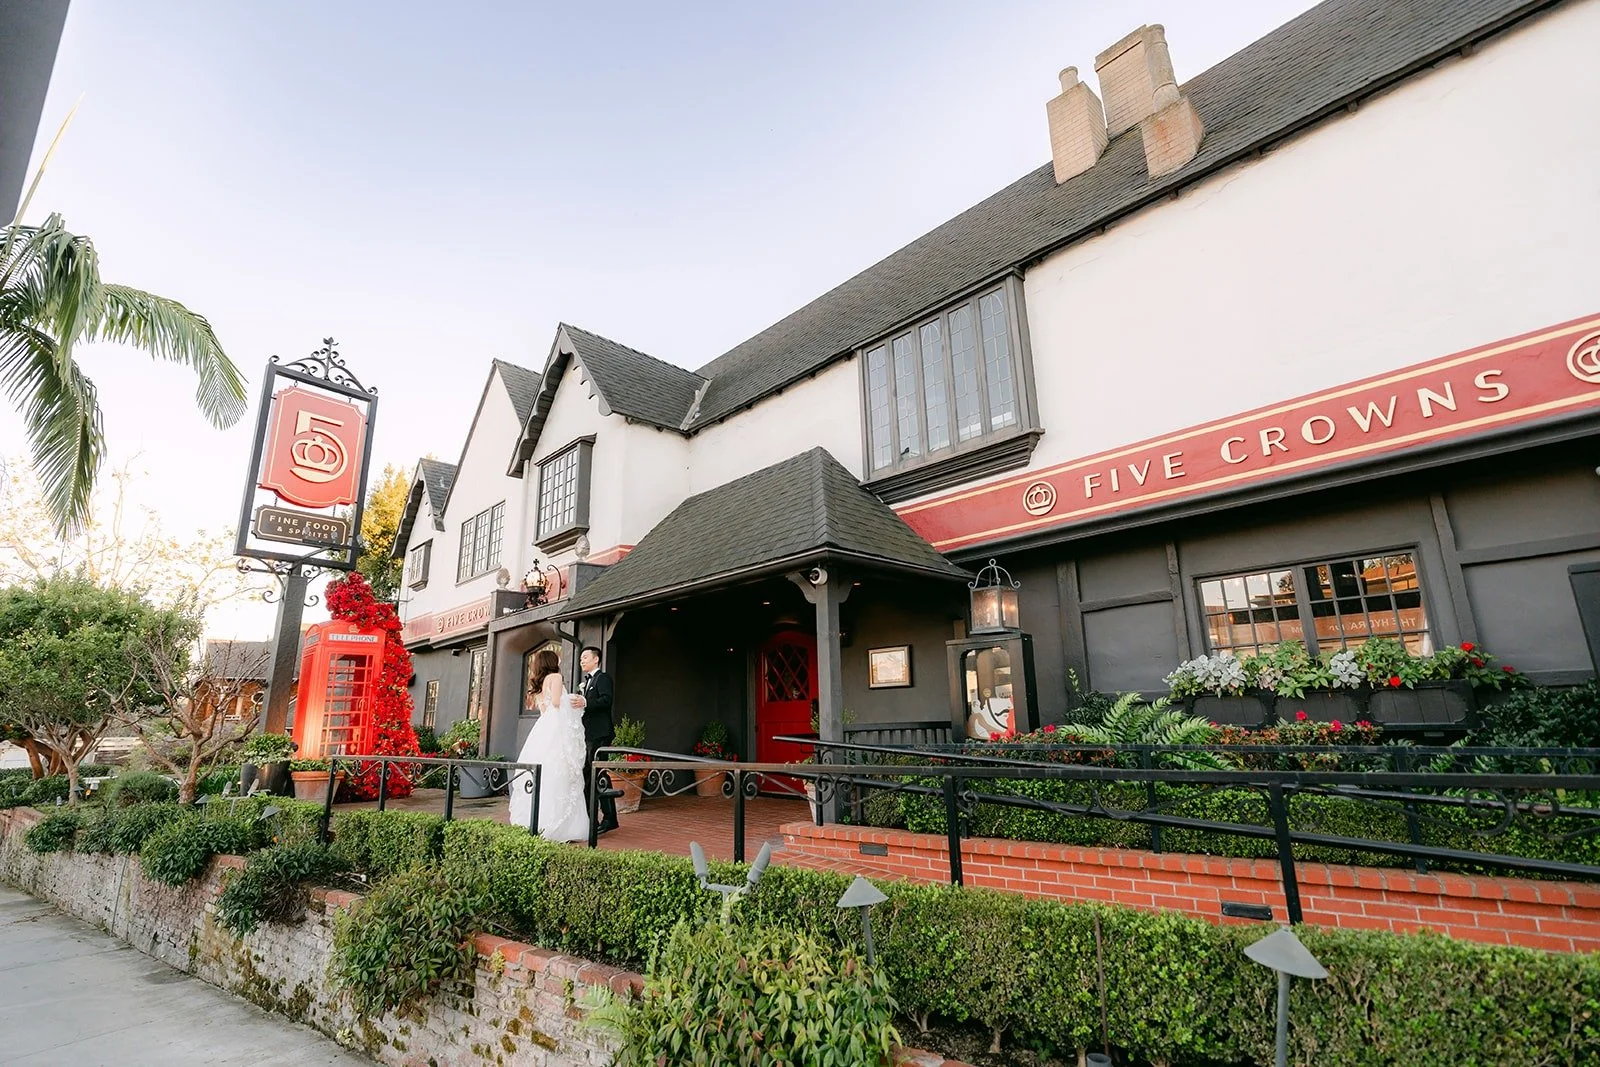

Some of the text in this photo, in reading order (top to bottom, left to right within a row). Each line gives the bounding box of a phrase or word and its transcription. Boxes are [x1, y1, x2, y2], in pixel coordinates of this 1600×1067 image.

[289, 409, 349, 484] 5
[1083, 369, 1510, 499] FIVE CROWNS
[269, 515, 338, 533] FINE FOOD
[446, 603, 491, 628] FIVE CROW
[331, 634, 375, 642] TELEPHONE
